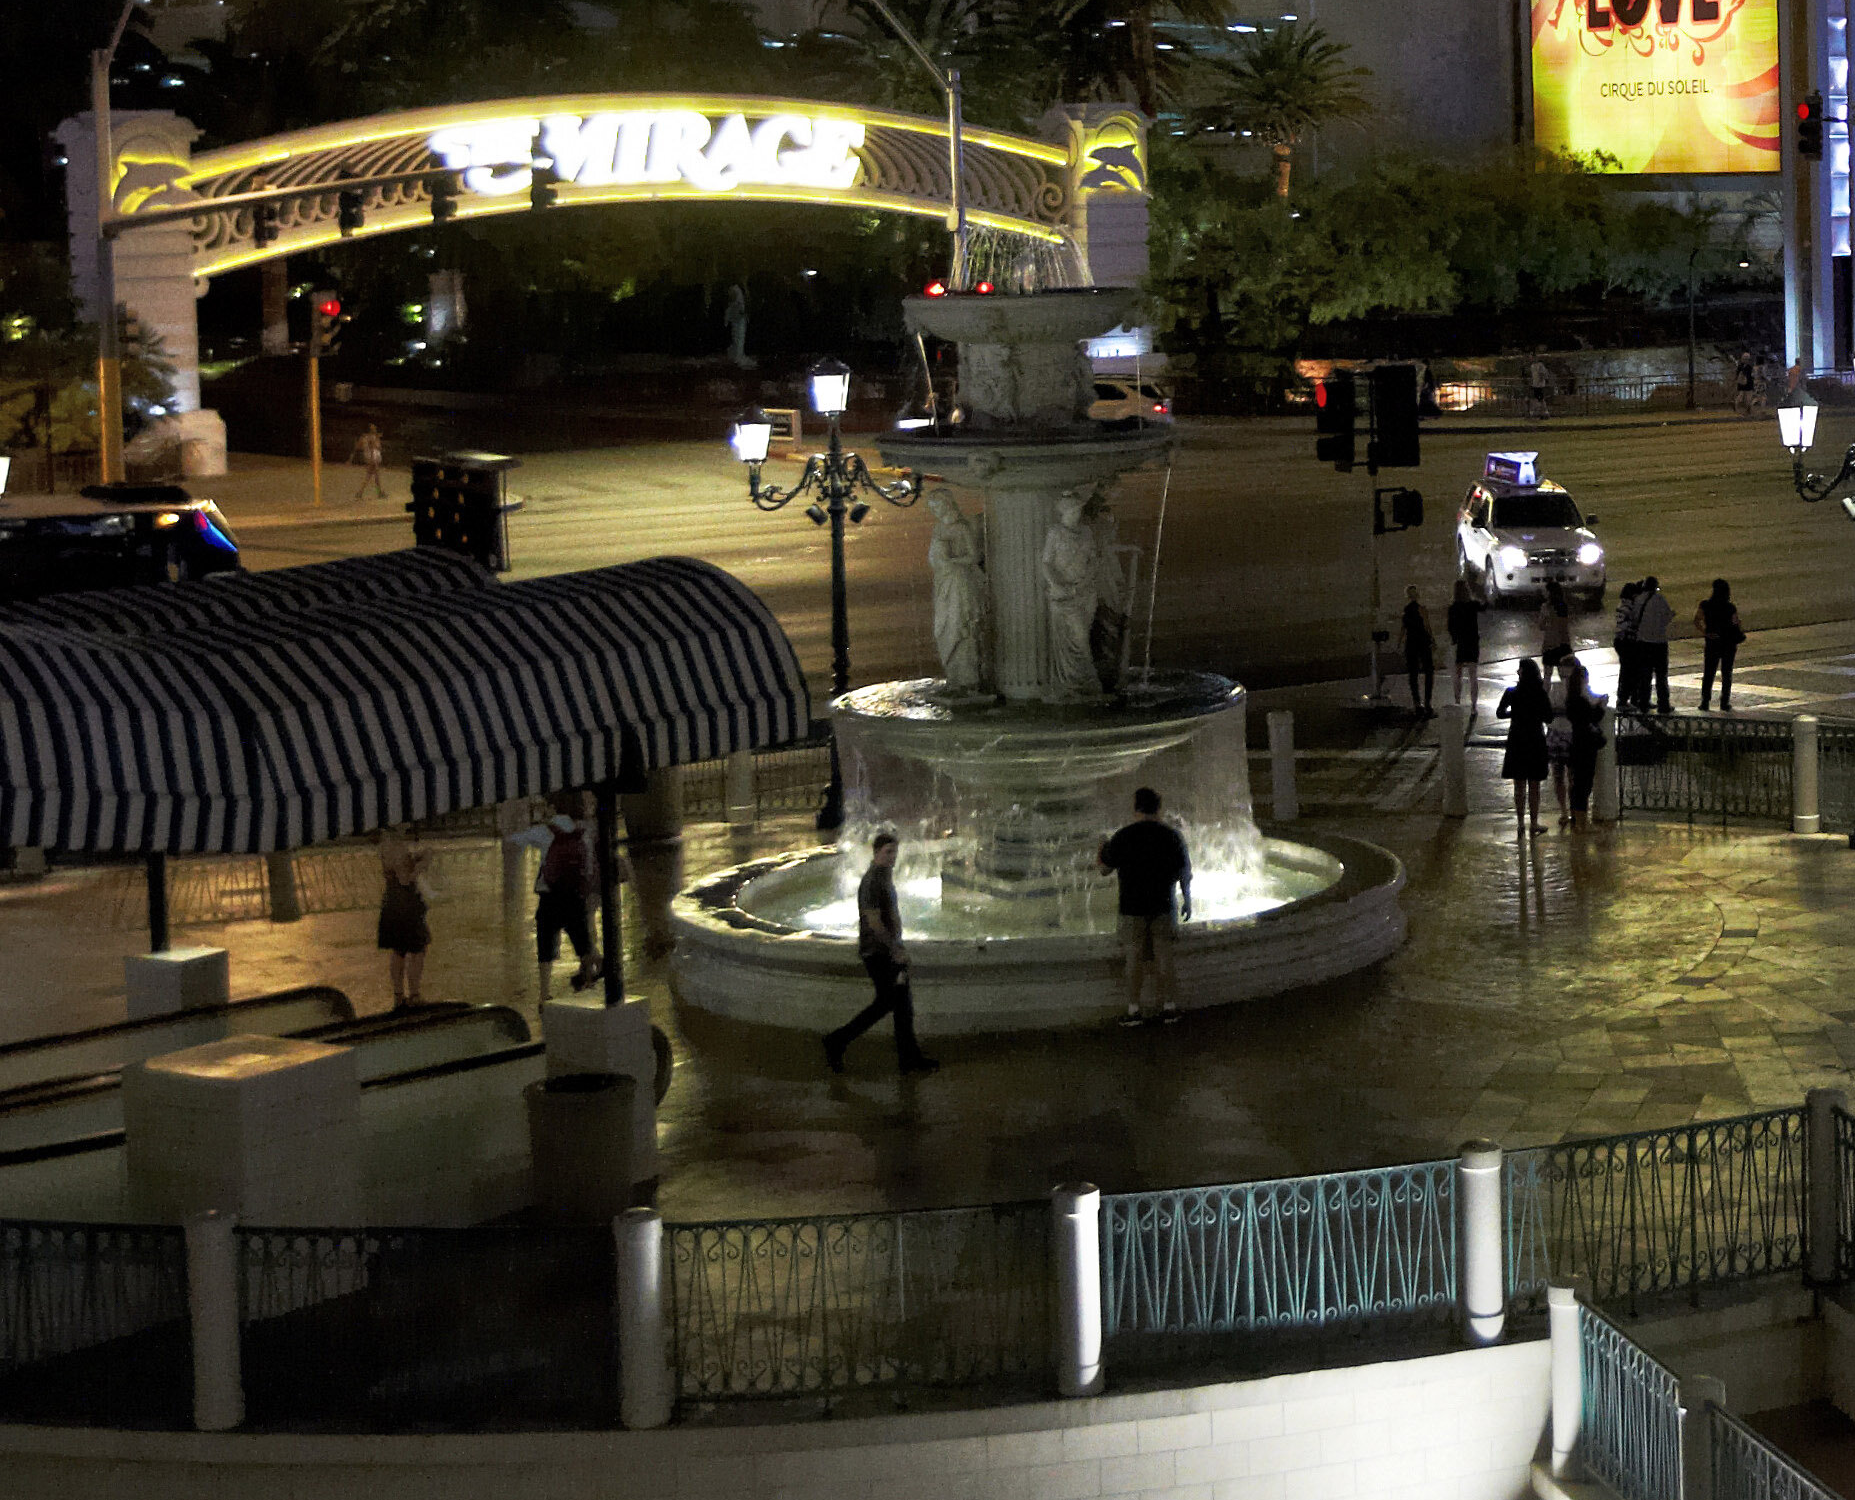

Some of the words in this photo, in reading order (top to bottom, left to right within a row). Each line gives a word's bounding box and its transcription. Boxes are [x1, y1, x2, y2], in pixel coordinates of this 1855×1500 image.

[1600, 82, 1643, 101] CIRQUE
[1647, 81, 1664, 95] DU
[1668, 79, 1709, 95] SOLEIL
[465, 110, 866, 196] MIRAGE
